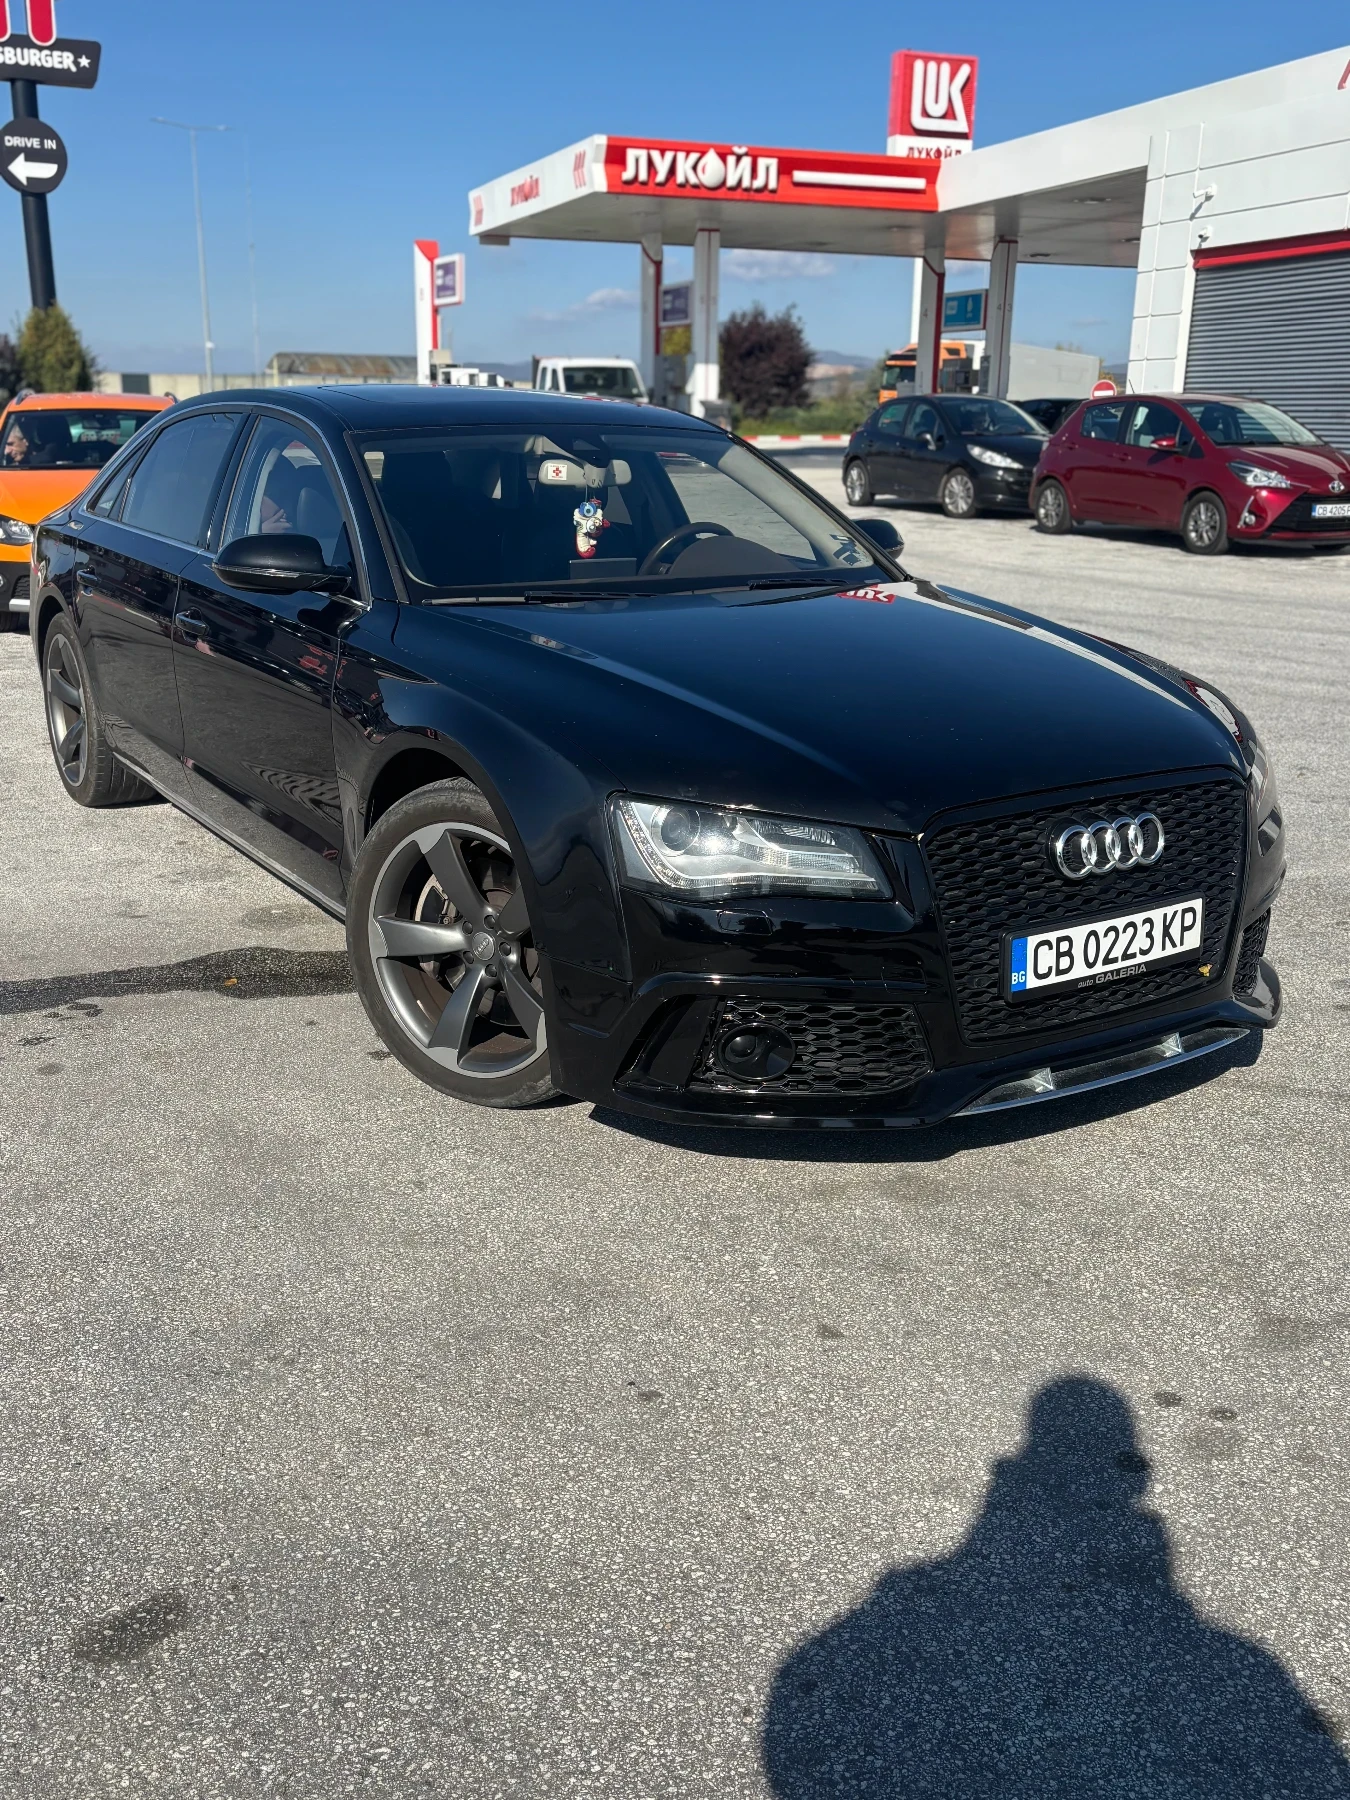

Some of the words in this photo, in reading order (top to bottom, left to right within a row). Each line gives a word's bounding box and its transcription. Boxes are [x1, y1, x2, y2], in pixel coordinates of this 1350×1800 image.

[4, 135, 41, 148] DRIVE
[44, 139, 57, 149] IN
[621, 145, 780, 191] ЛУКОЙЛ
[1317, 506, 1328, 516] CB
[1033, 935, 1075, 981] CB
[1083, 917, 1155, 970] 0223
[1161, 906, 1197, 952] KP
[1011, 970, 1026, 985] BG
[1077, 978, 1094, 989] auto
[1095, 964, 1147, 984] GALERIA
